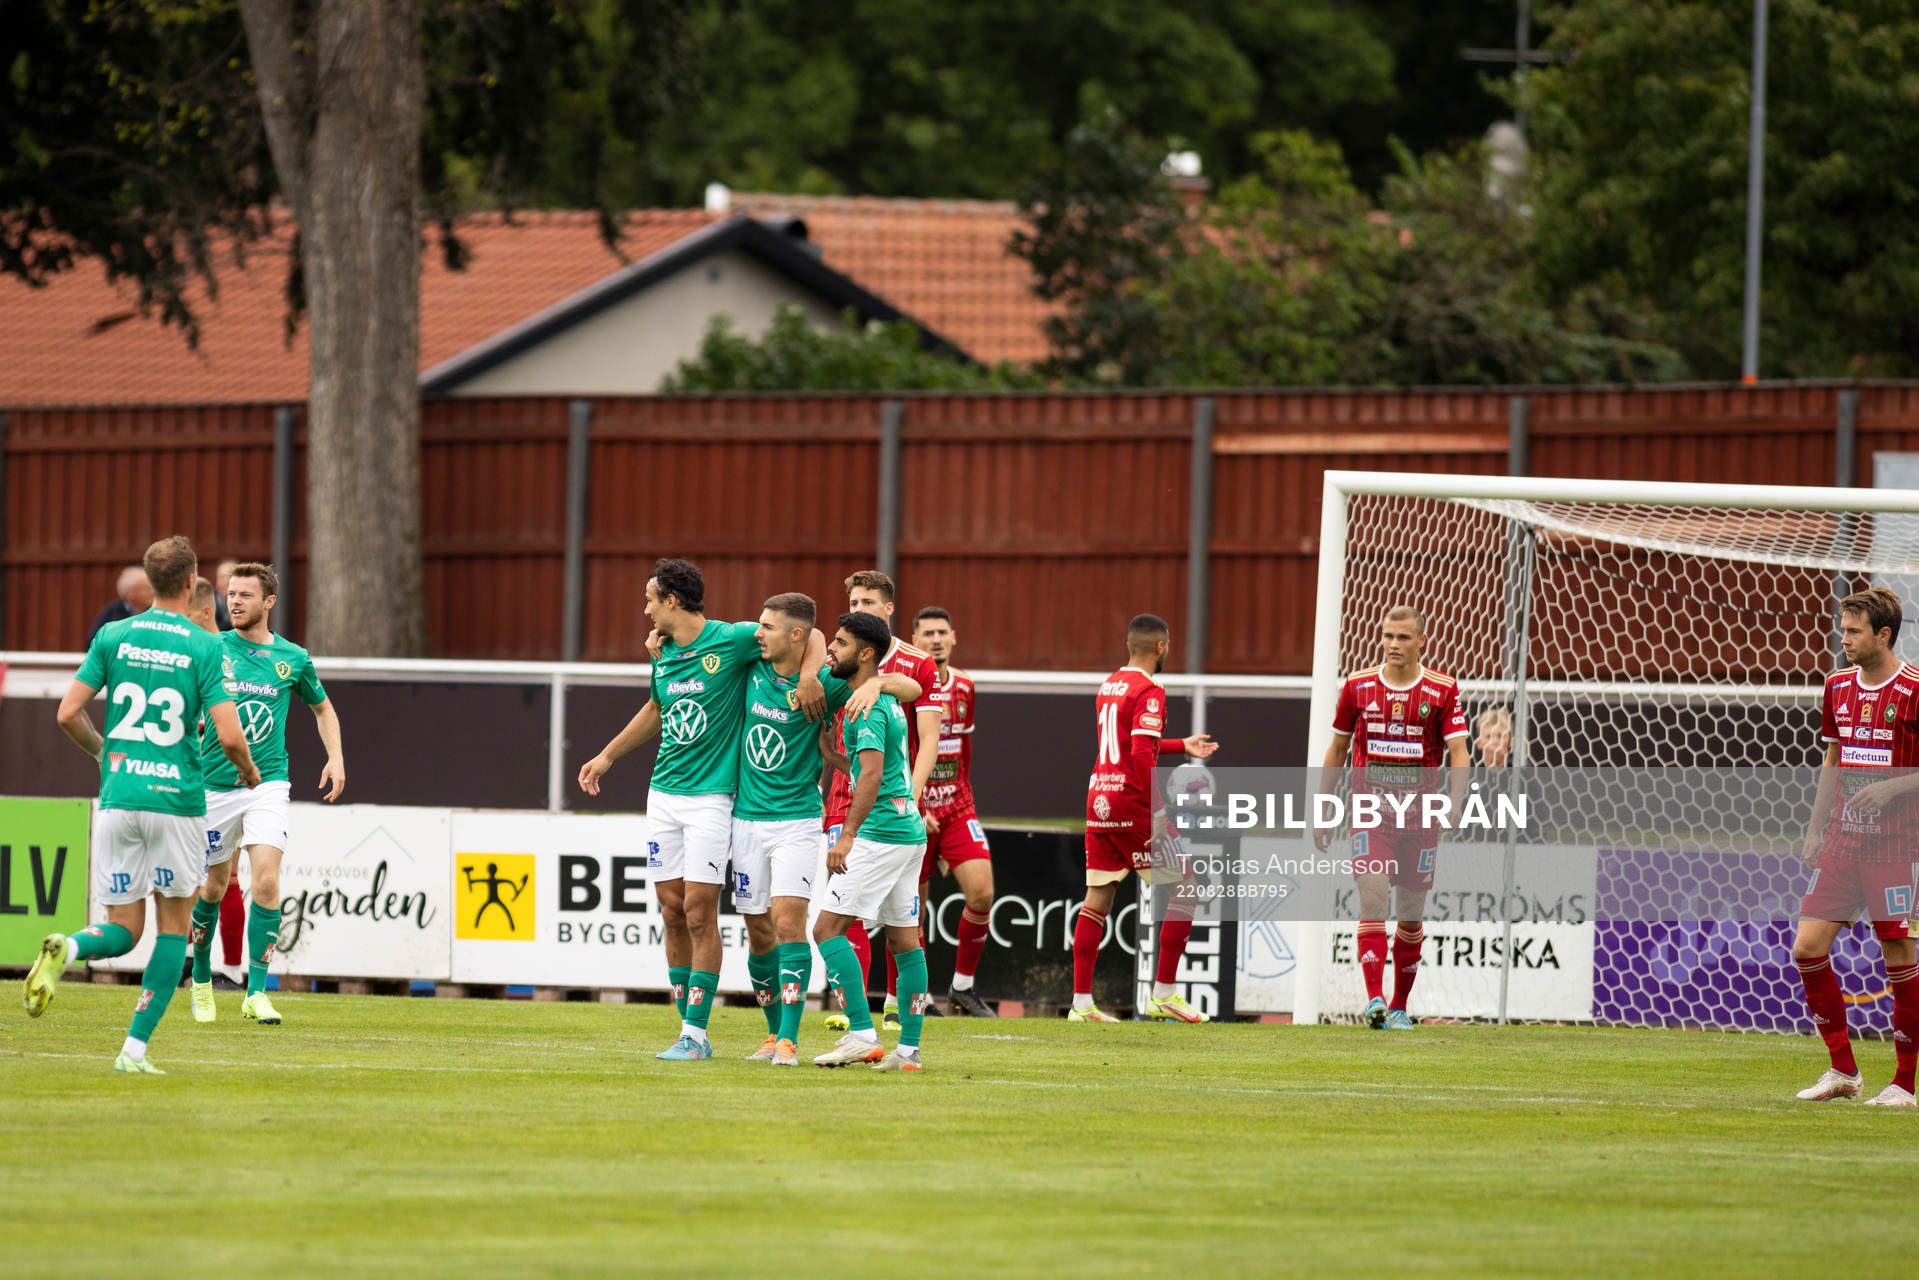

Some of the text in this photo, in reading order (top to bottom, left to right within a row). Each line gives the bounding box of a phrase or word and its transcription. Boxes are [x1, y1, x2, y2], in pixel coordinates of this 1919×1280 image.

[131, 620, 190, 637] DAHLSTRÖM
[117, 643, 192, 669] Passera
[238, 681, 279, 697] Atteviks
[667, 679, 704, 695] Atteviks
[1098, 679, 1129, 696] renta
[107, 681, 185, 747] 23
[751, 702, 789, 721] Atteviks
[1369, 743, 1421, 755] Perfectum
[125, 758, 181, 780] YUASA
[1382, 774, 1411, 784] HUSET
[1131, 851, 1163, 863] PULS
[110, 873, 131, 894] JP
[154, 867, 174, 887] JP
[1335, 886, 1587, 926] KLSTRÖMS
[1332, 932, 1560, 970] ETRISKA
